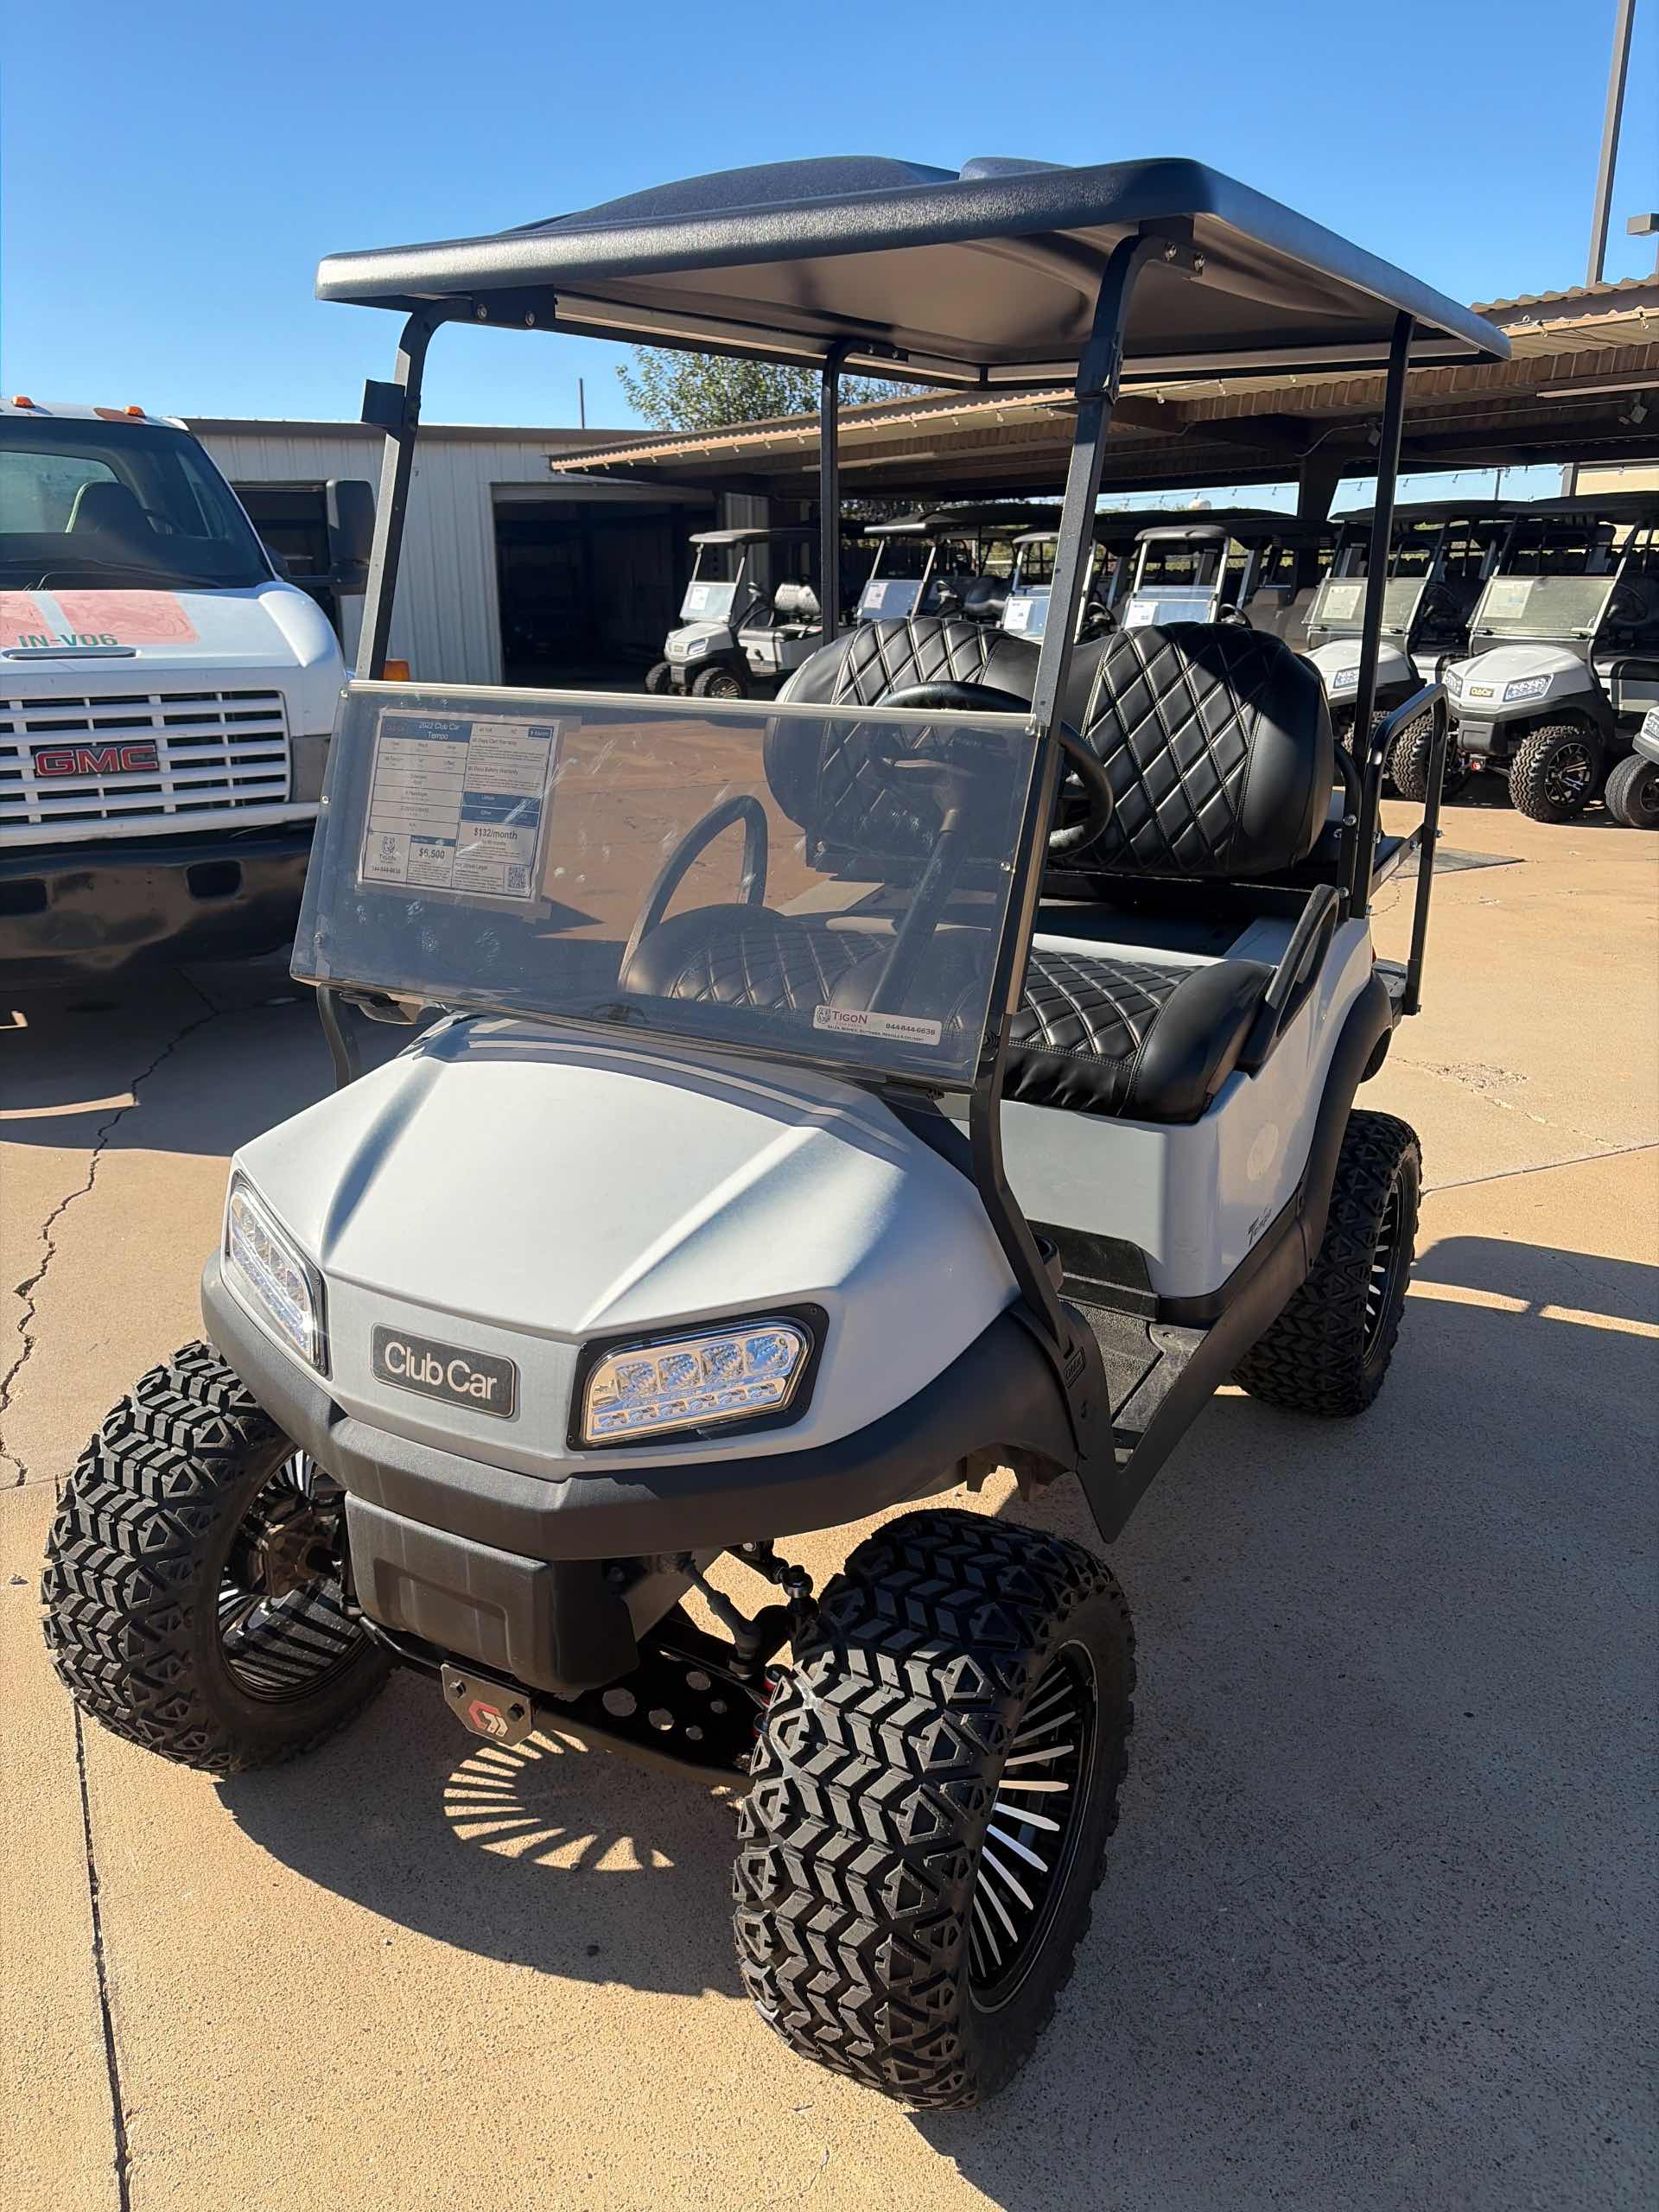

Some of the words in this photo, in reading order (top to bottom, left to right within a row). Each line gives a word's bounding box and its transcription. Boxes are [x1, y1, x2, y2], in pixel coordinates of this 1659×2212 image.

[428, 731, 449, 740] Tempo
[35, 745, 159, 777] GMC
[474, 827, 518, 840] $132/month
[418, 848, 445, 859] $6,500
[385, 1341, 443, 1386] Club
[447, 1359, 498, 1400] Car
